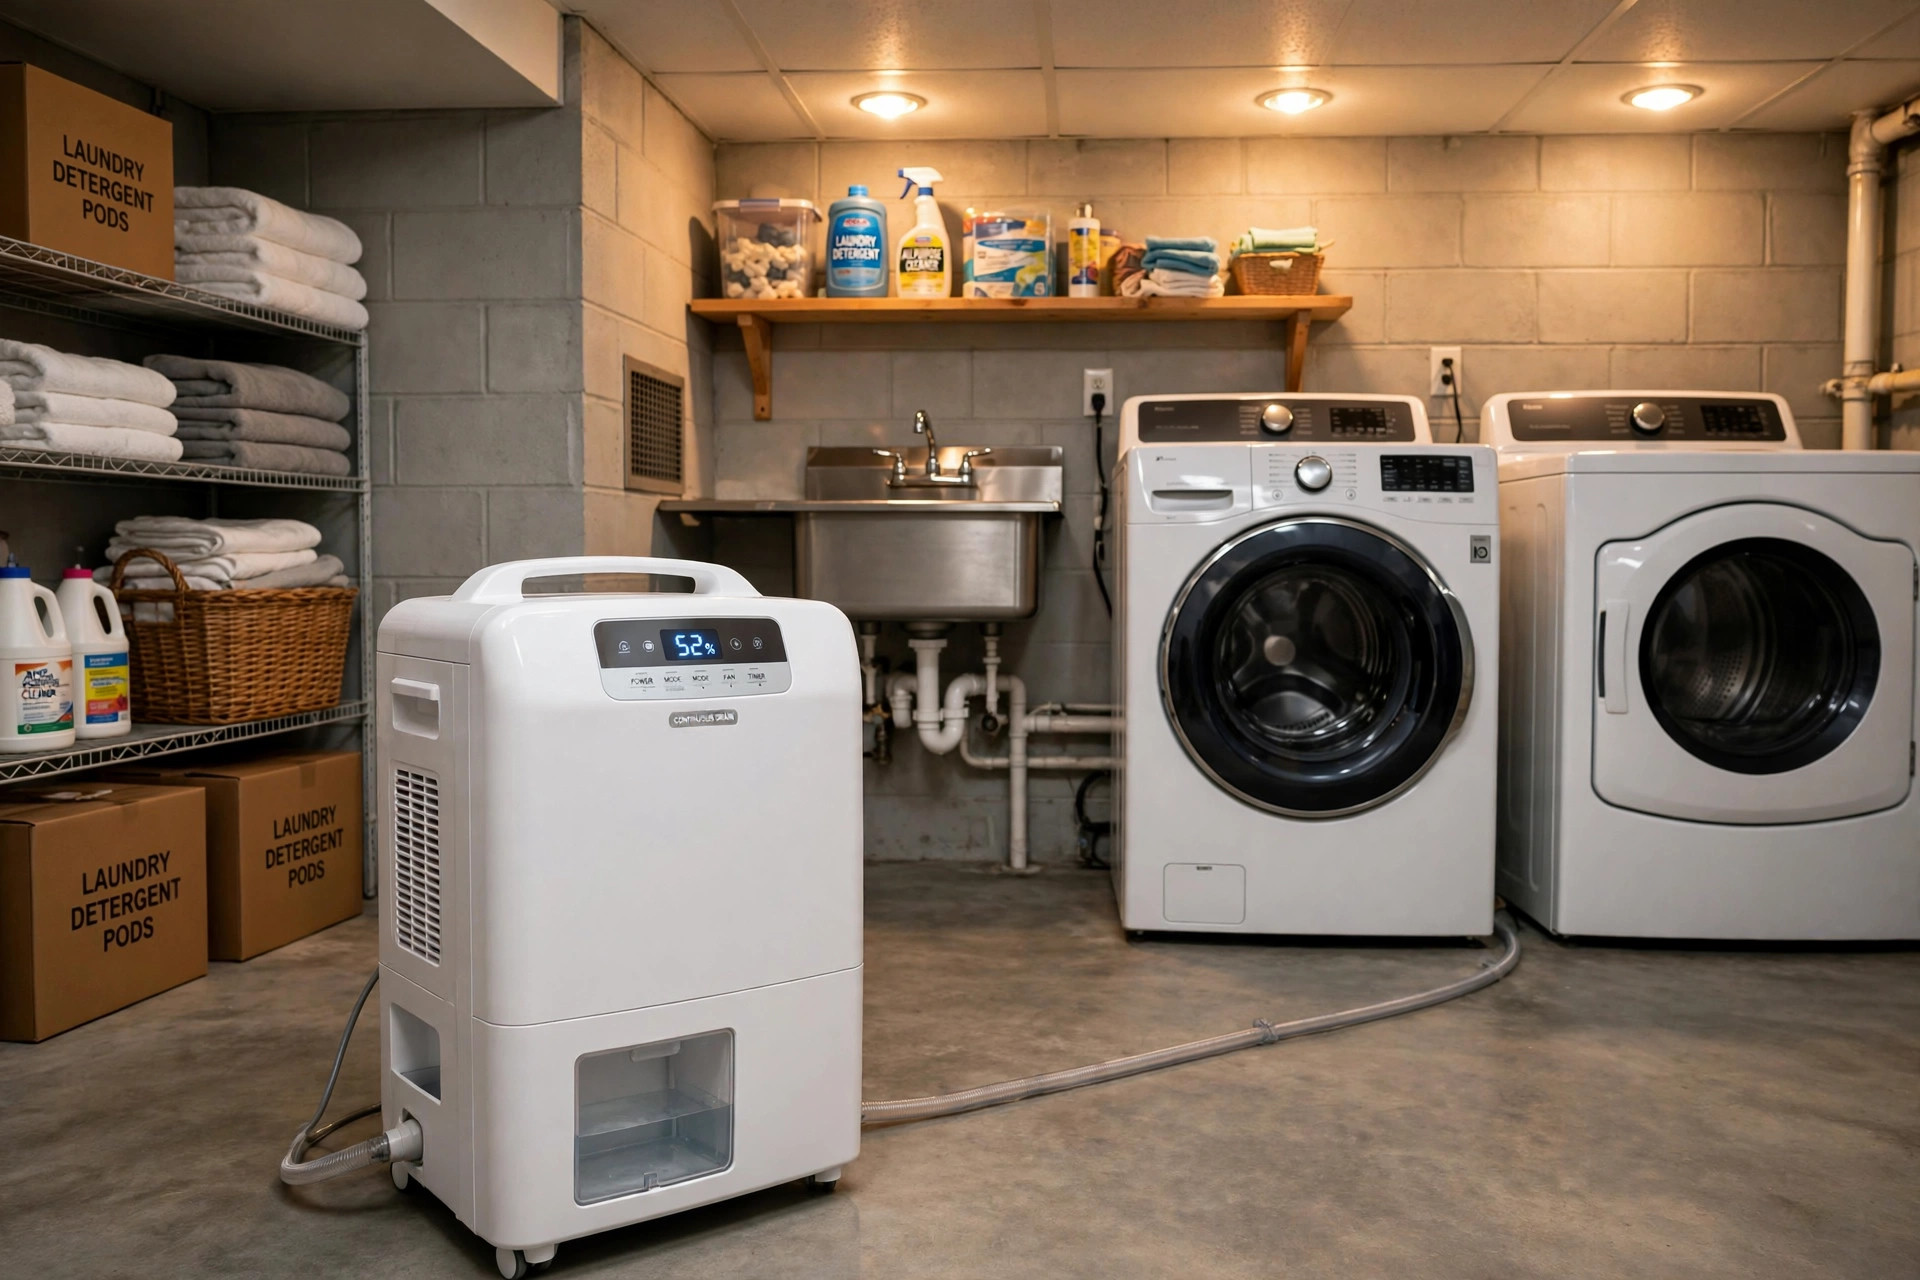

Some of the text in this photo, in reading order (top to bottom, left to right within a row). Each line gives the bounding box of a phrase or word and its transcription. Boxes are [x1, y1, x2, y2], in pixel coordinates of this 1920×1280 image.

[63, 134, 145, 182] LAUNDRY
[53, 159, 154, 213] DETERGENT
[82, 198, 129, 232] PODS
[832, 247, 880, 261] DETERGENT
[835, 234, 877, 248] LAUNDRY
[630, 677, 654, 685] POWER
[273, 804, 337, 840] LAUNDRY
[265, 828, 344, 870] DETERGENT
[82, 850, 171, 896] LAUNDRY
[288, 859, 326, 889] PODS
[71, 877, 181, 931] DETERGENT
[103, 916, 154, 953] PODS
